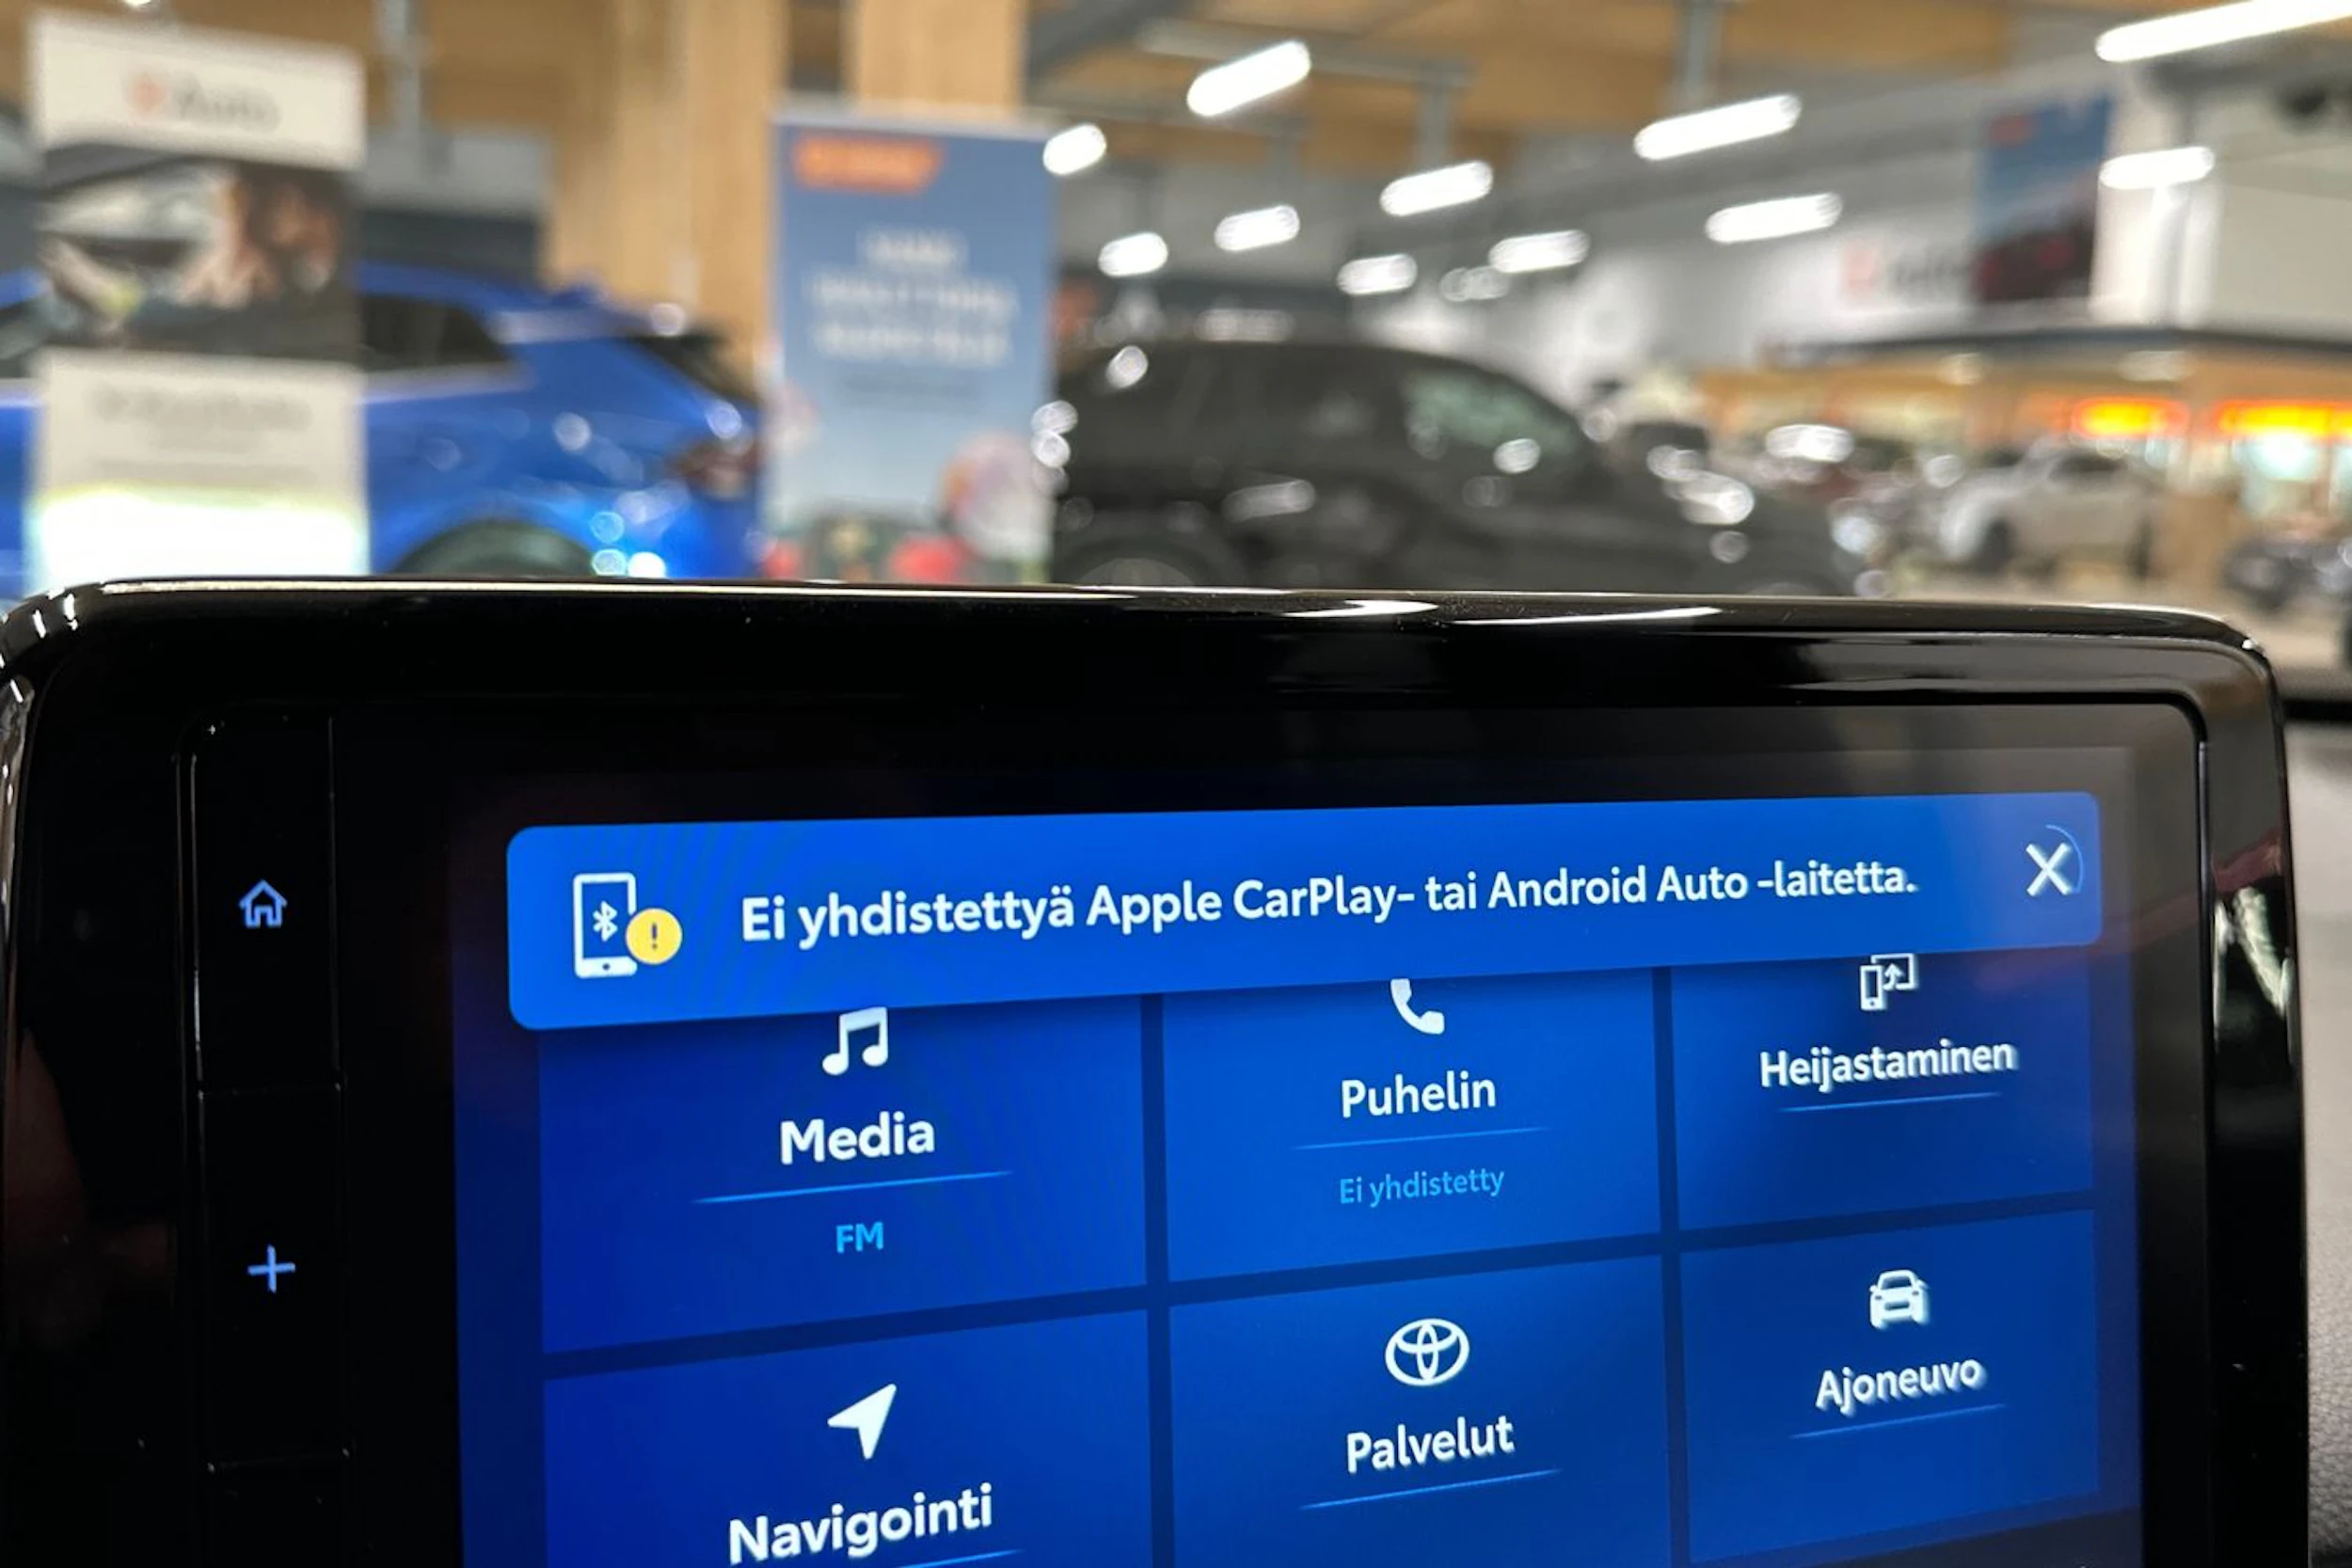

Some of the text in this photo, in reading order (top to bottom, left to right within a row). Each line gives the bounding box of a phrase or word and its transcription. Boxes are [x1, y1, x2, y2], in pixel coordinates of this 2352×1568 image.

[742, 859, 1917, 950] Ei yhdistettyä Apple CarPlay- tai Android Auto -laitetta.
[1759, 1038, 2017, 1093] Heijastaminen
[1342, 1070, 1497, 1118] Puhelin
[780, 1111, 936, 1165] Media
[1340, 1167, 1505, 1209] Ei yhdistetty
[835, 1221, 884, 1254] FM
[1815, 1359, 1985, 1416] Ajoneuvo
[1345, 1415, 1516, 1474] Palvelut
[728, 1481, 993, 1565] Navigointi
